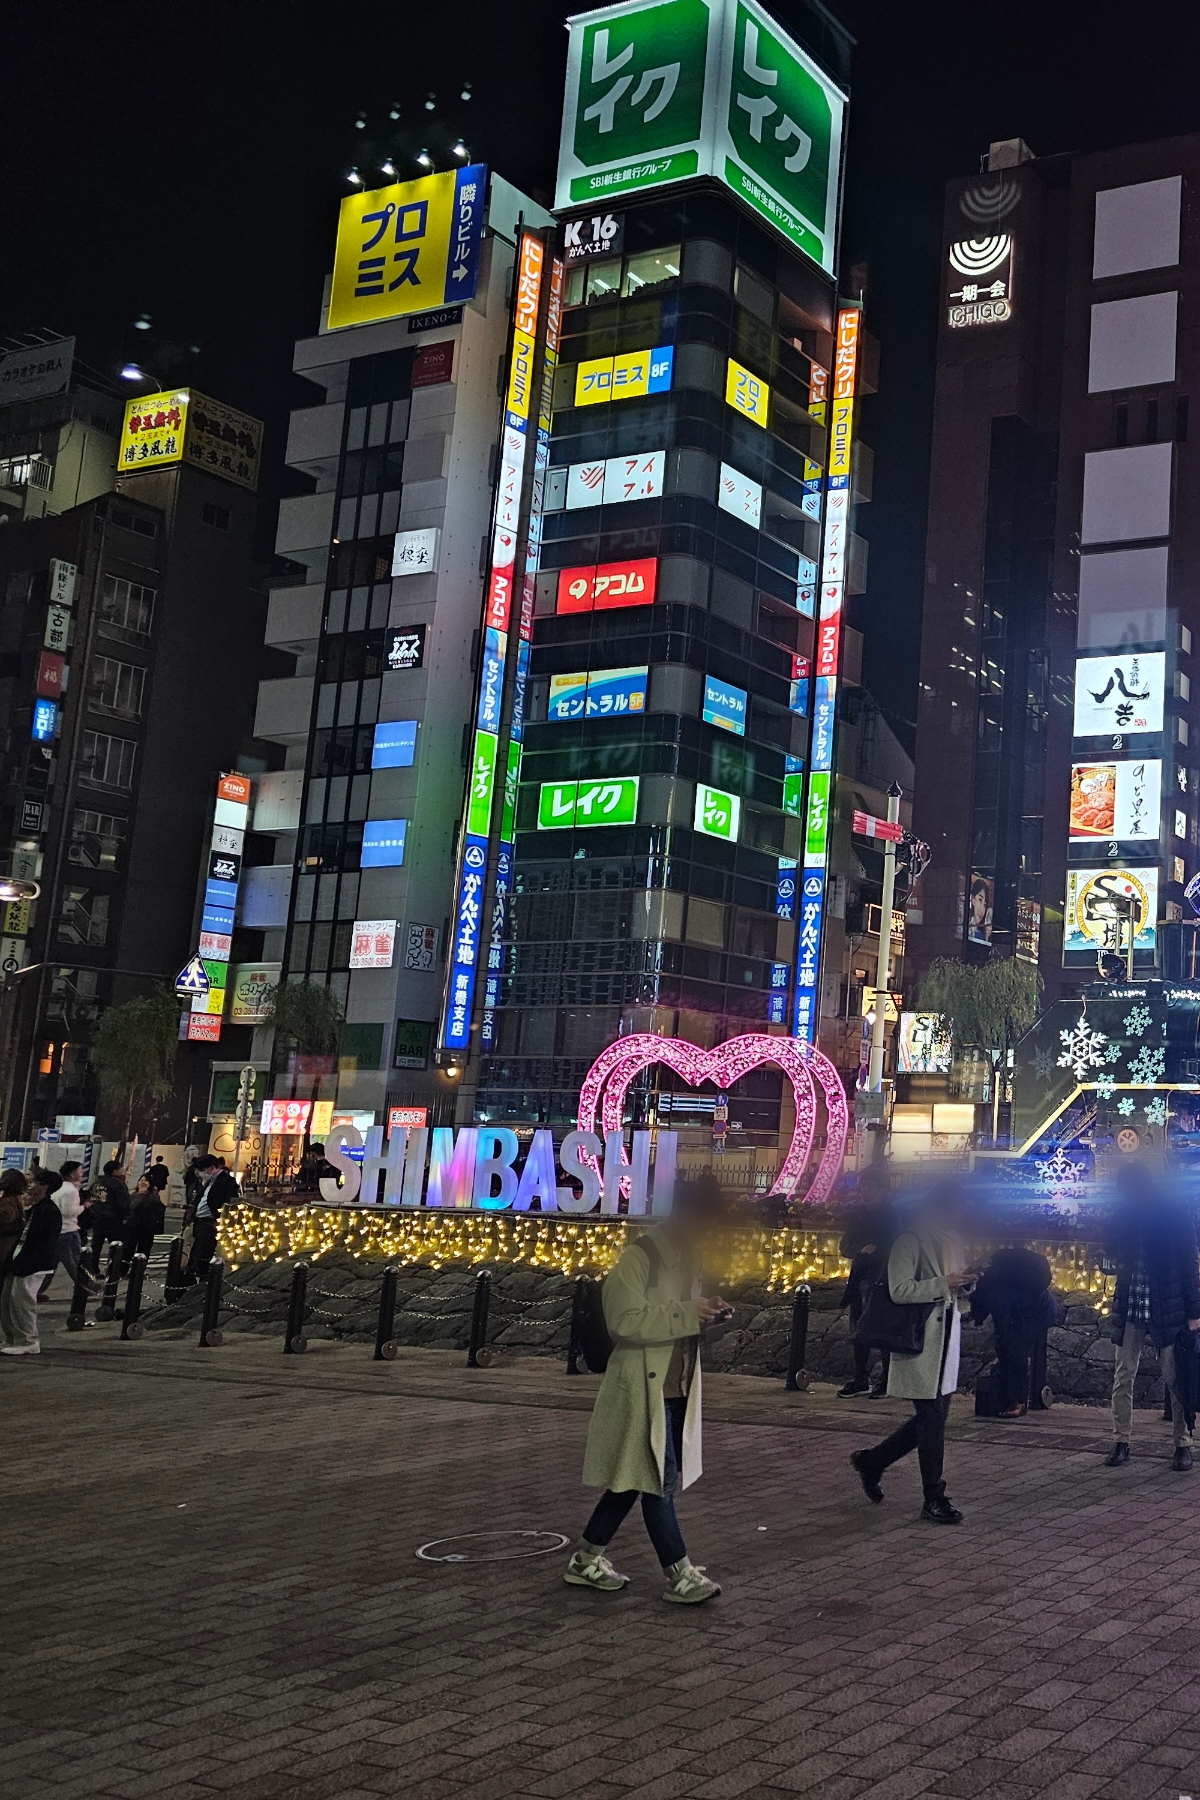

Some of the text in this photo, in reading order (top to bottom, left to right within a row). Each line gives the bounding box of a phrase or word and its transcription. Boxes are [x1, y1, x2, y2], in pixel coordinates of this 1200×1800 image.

[584, 29, 680, 133] レイク
[737, 18, 812, 173] レイク
[589, 160, 673, 189] SBI新生銀行グループ
[453, 183, 477, 263] 隣りビル
[741, 175, 806, 237] SBI新生銀行グループ
[564, 214, 618, 248] K 16
[568, 238, 612, 259] かんべ土地
[517, 238, 542, 334] にしだクリ
[949, 279, 1007, 303] 一期一会
[411, 310, 458, 329] IKENO-7
[948, 300, 1012, 329] ICHIGO
[423, 353, 446, 364] ZINO
[651, 360, 670, 379] 8F
[836, 312, 858, 399] にしだクリ
[512, 341, 531, 407] プロミス
[582, 365, 645, 392] プロミス
[508, 416, 523, 429] 8F
[833, 405, 851, 467] プロミス
[124, 435, 178, 463] 博多風龍
[501, 464, 516, 523] アイフル
[830, 476, 847, 488] 8F
[827, 523, 841, 577] アイフル
[488, 574, 508, 618] アコム
[591, 571, 645, 599] アコム
[49, 612, 66, 645] 古都
[491, 617, 505, 628] 6F
[822, 625, 837, 664] アコム
[820, 665, 833, 675] 6F
[482, 658, 500, 721] セントラル
[555, 693, 629, 718] セントラル
[630, 694, 645, 707] 5F
[706, 687, 744, 713] セントラル
[815, 702, 831, 763] セントラル
[223, 782, 245, 794] ZINO
[473, 755, 491, 800] レイク
[24, 804, 40, 816] BAR
[550, 784, 624, 818] レイク
[703, 790, 727, 828] レイク
[810, 791, 826, 832] レイク
[354, 922, 394, 932] セット・フリー
[456, 872, 482, 966] かんべ土地
[352, 931, 393, 957] 麻雀
[406, 924, 425, 968] ホワイト
[799, 901, 821, 988] かんべ土地
[451, 973, 470, 1038] 新橋支店
[318, 1124, 678, 1217] SHIMBASHI
